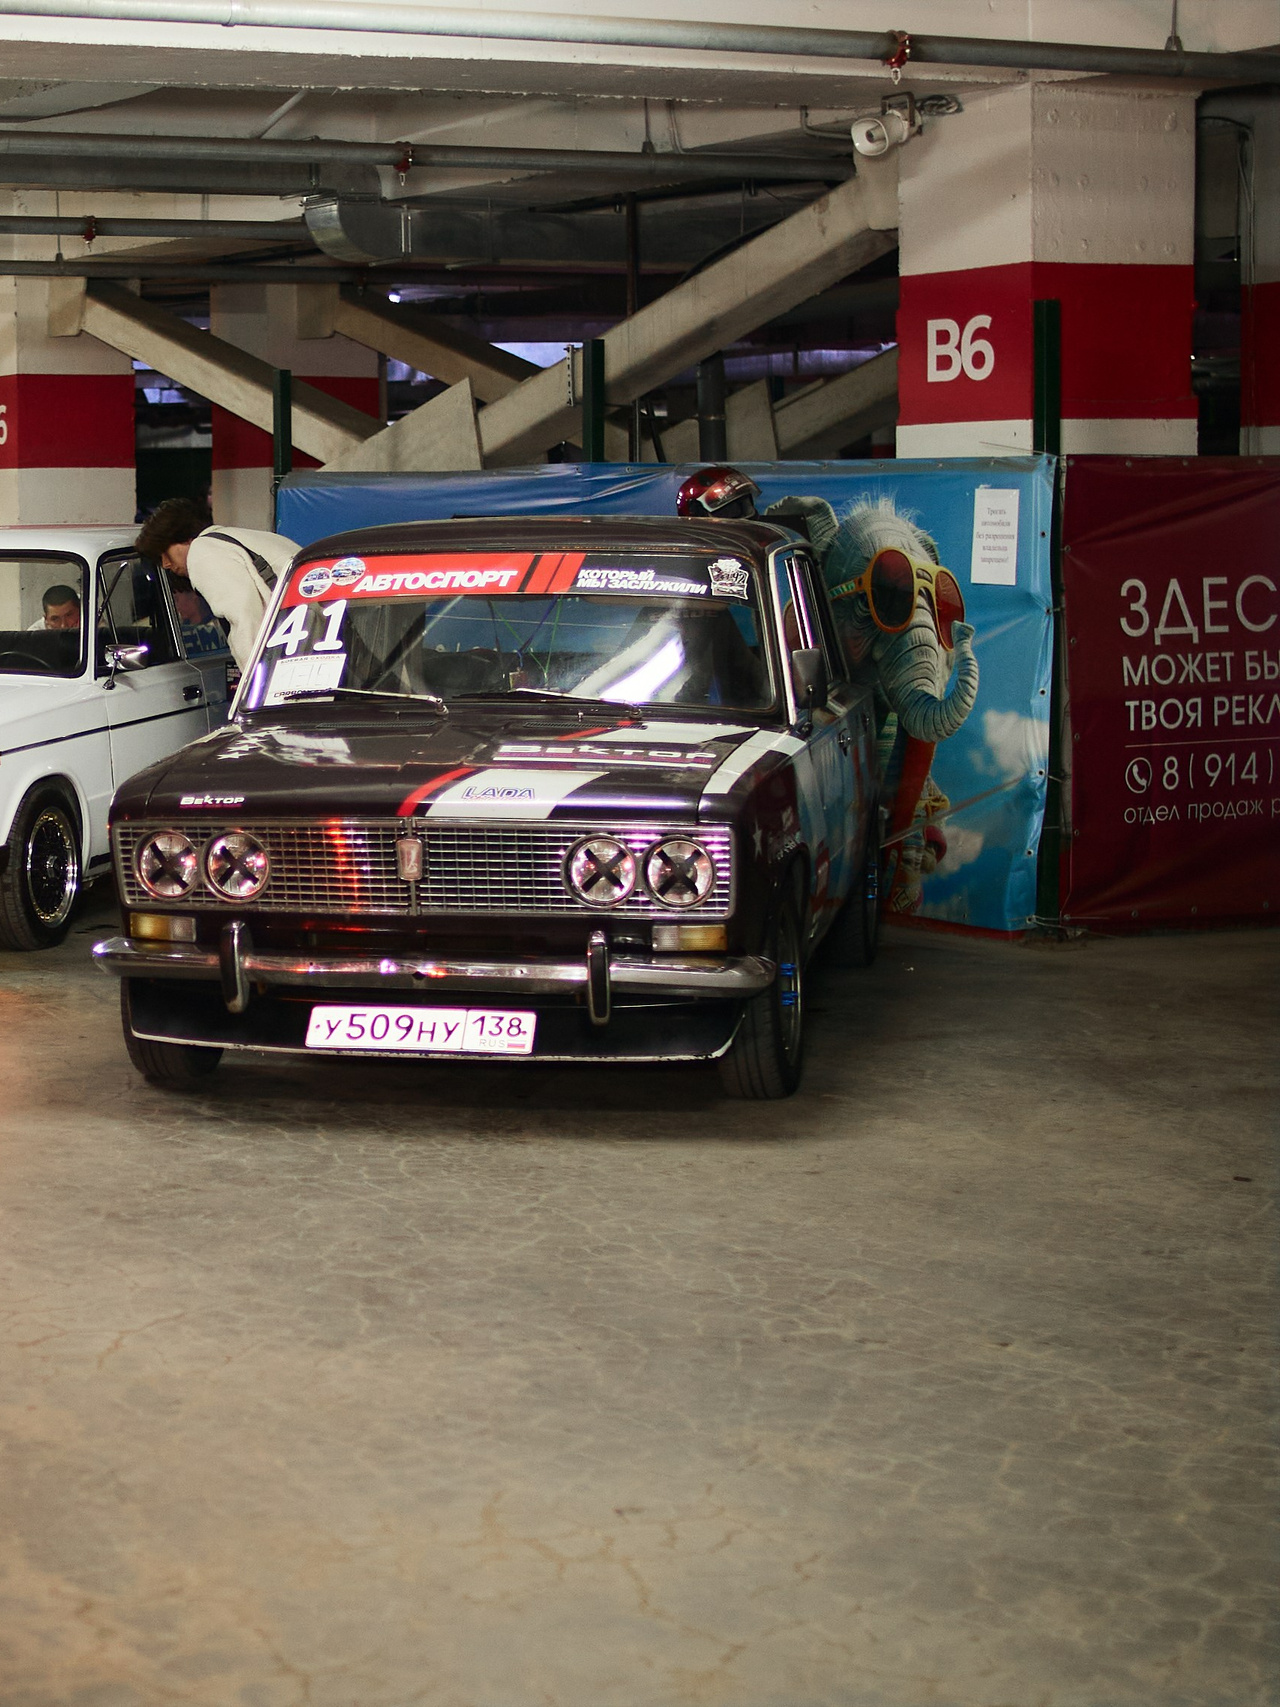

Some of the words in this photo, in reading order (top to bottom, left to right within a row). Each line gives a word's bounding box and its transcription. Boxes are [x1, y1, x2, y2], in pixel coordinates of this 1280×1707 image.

[352, 570, 519, 593] АВТОСПОРТ
[577, 569, 656, 581] КОТОРЫЙ
[576, 578, 607, 589] МЫ
[608, 579, 708, 595] ЗАСЛУЖИЛИ
[266, 599, 348, 656] 41
[1122, 652, 1235, 687] МОЖЕТ
[1125, 697, 1202, 731] ТВОЯ
[461, 786, 536, 800] LADA
[1124, 804, 1180, 825] отдел
[1187, 798, 1264, 824] продаж
[472, 1015, 523, 1037] 138
[479, 1038, 506, 1048] RUS
